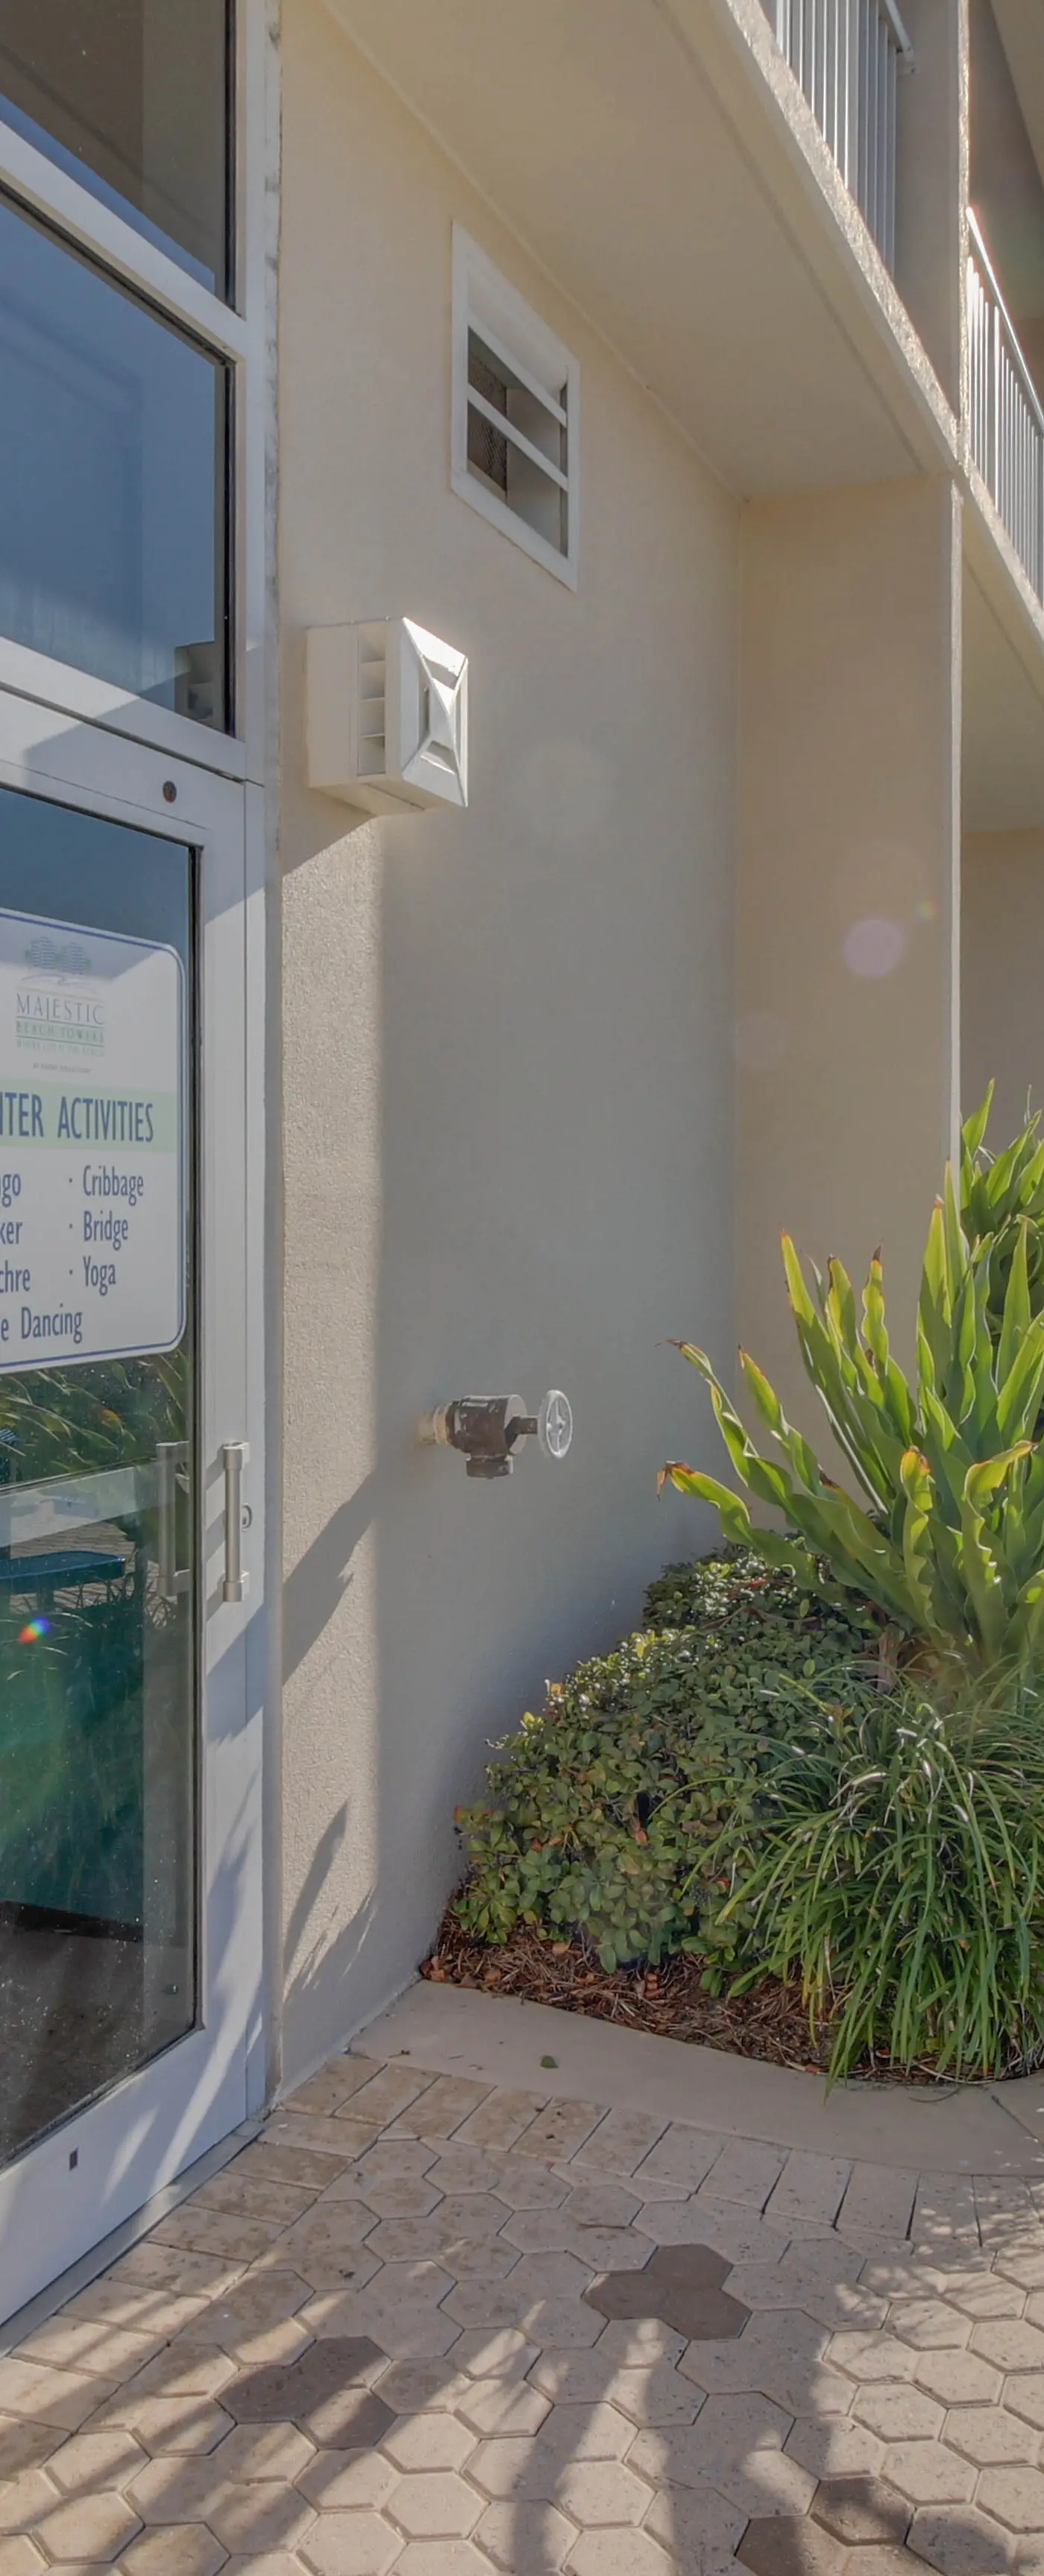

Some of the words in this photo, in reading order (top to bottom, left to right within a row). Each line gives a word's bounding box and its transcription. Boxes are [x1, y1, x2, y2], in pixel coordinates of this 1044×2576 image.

[15, 992, 105, 1026] MAJESTIC
[0, 1091, 44, 1137] TER
[57, 1096, 154, 1143] ACTIVITIES
[83, 1165, 144, 1207] Cribbage
[83, 1210, 129, 1251] Bridge
[83, 1256, 116, 1297] Yoga
[21, 1302, 83, 1344] Dancing
